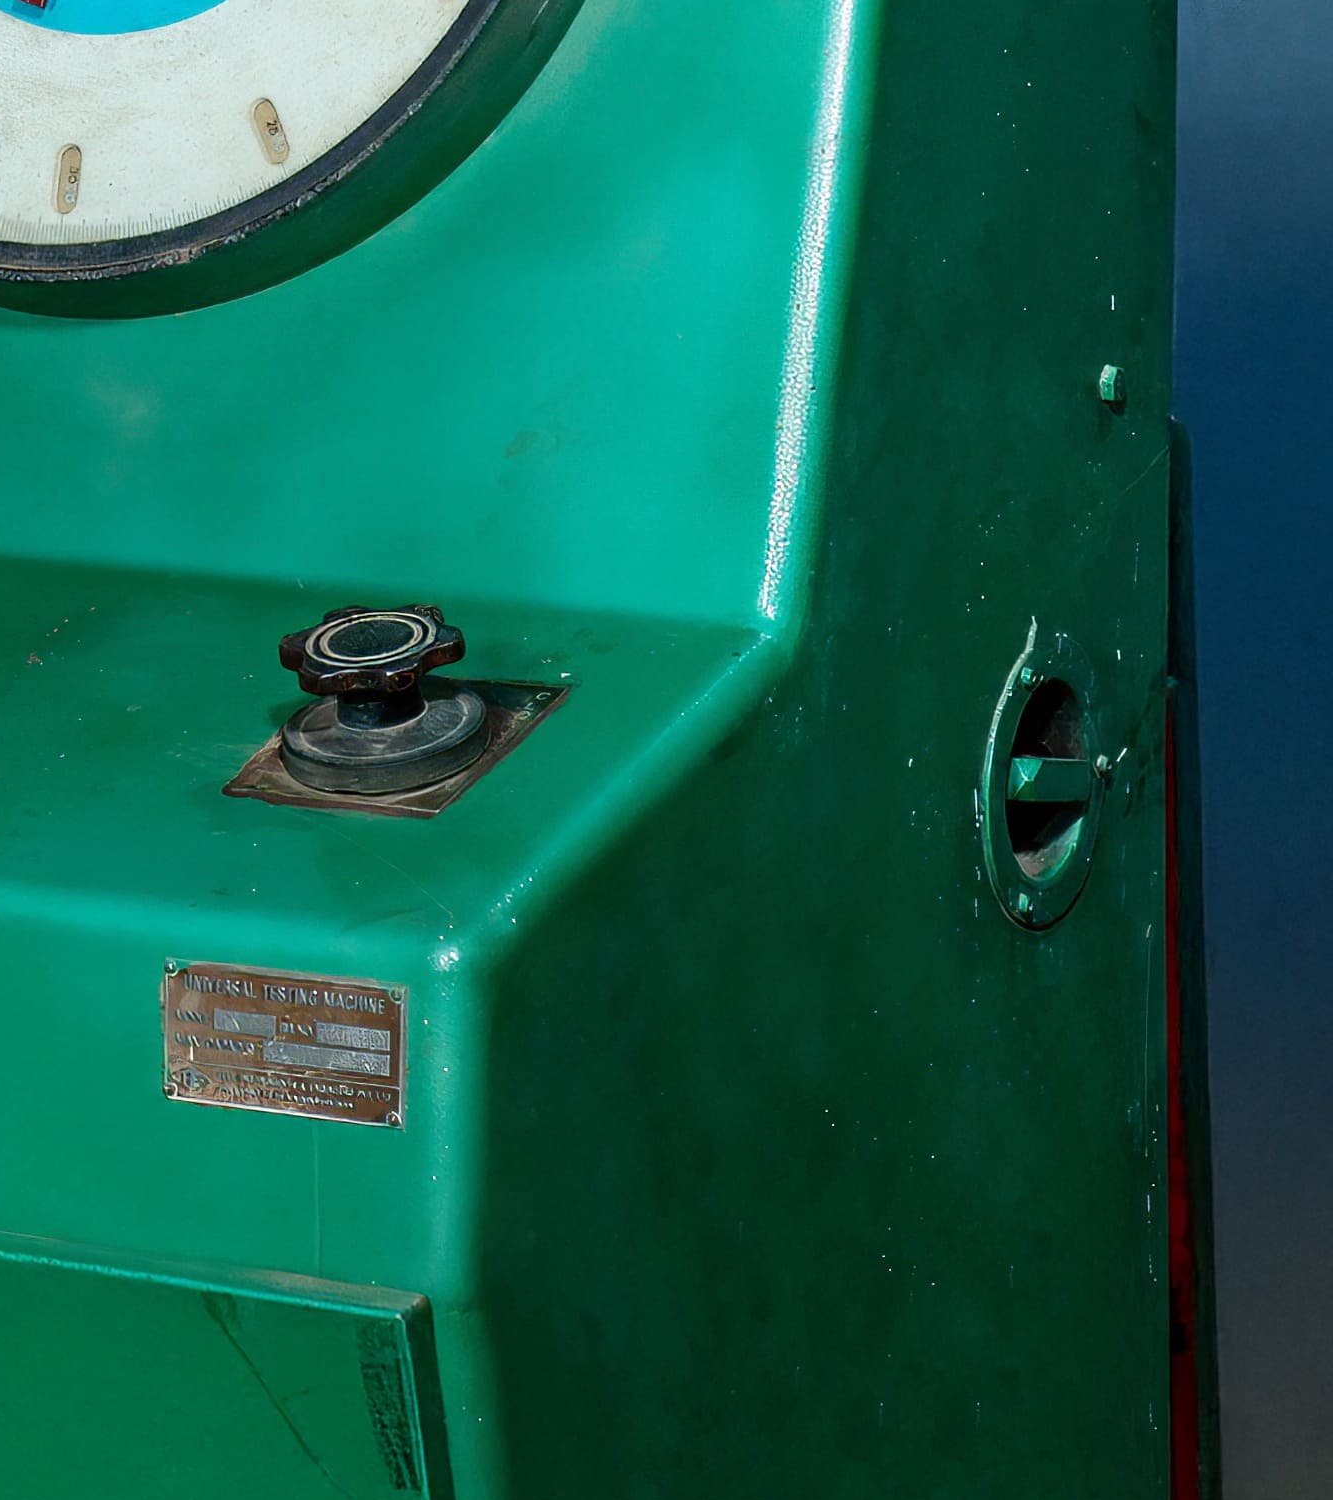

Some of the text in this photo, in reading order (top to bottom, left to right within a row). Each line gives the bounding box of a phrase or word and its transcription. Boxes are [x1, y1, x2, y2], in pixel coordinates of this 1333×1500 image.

[183, 973, 386, 1016] UNIVERSAL TESTING MACHINE
